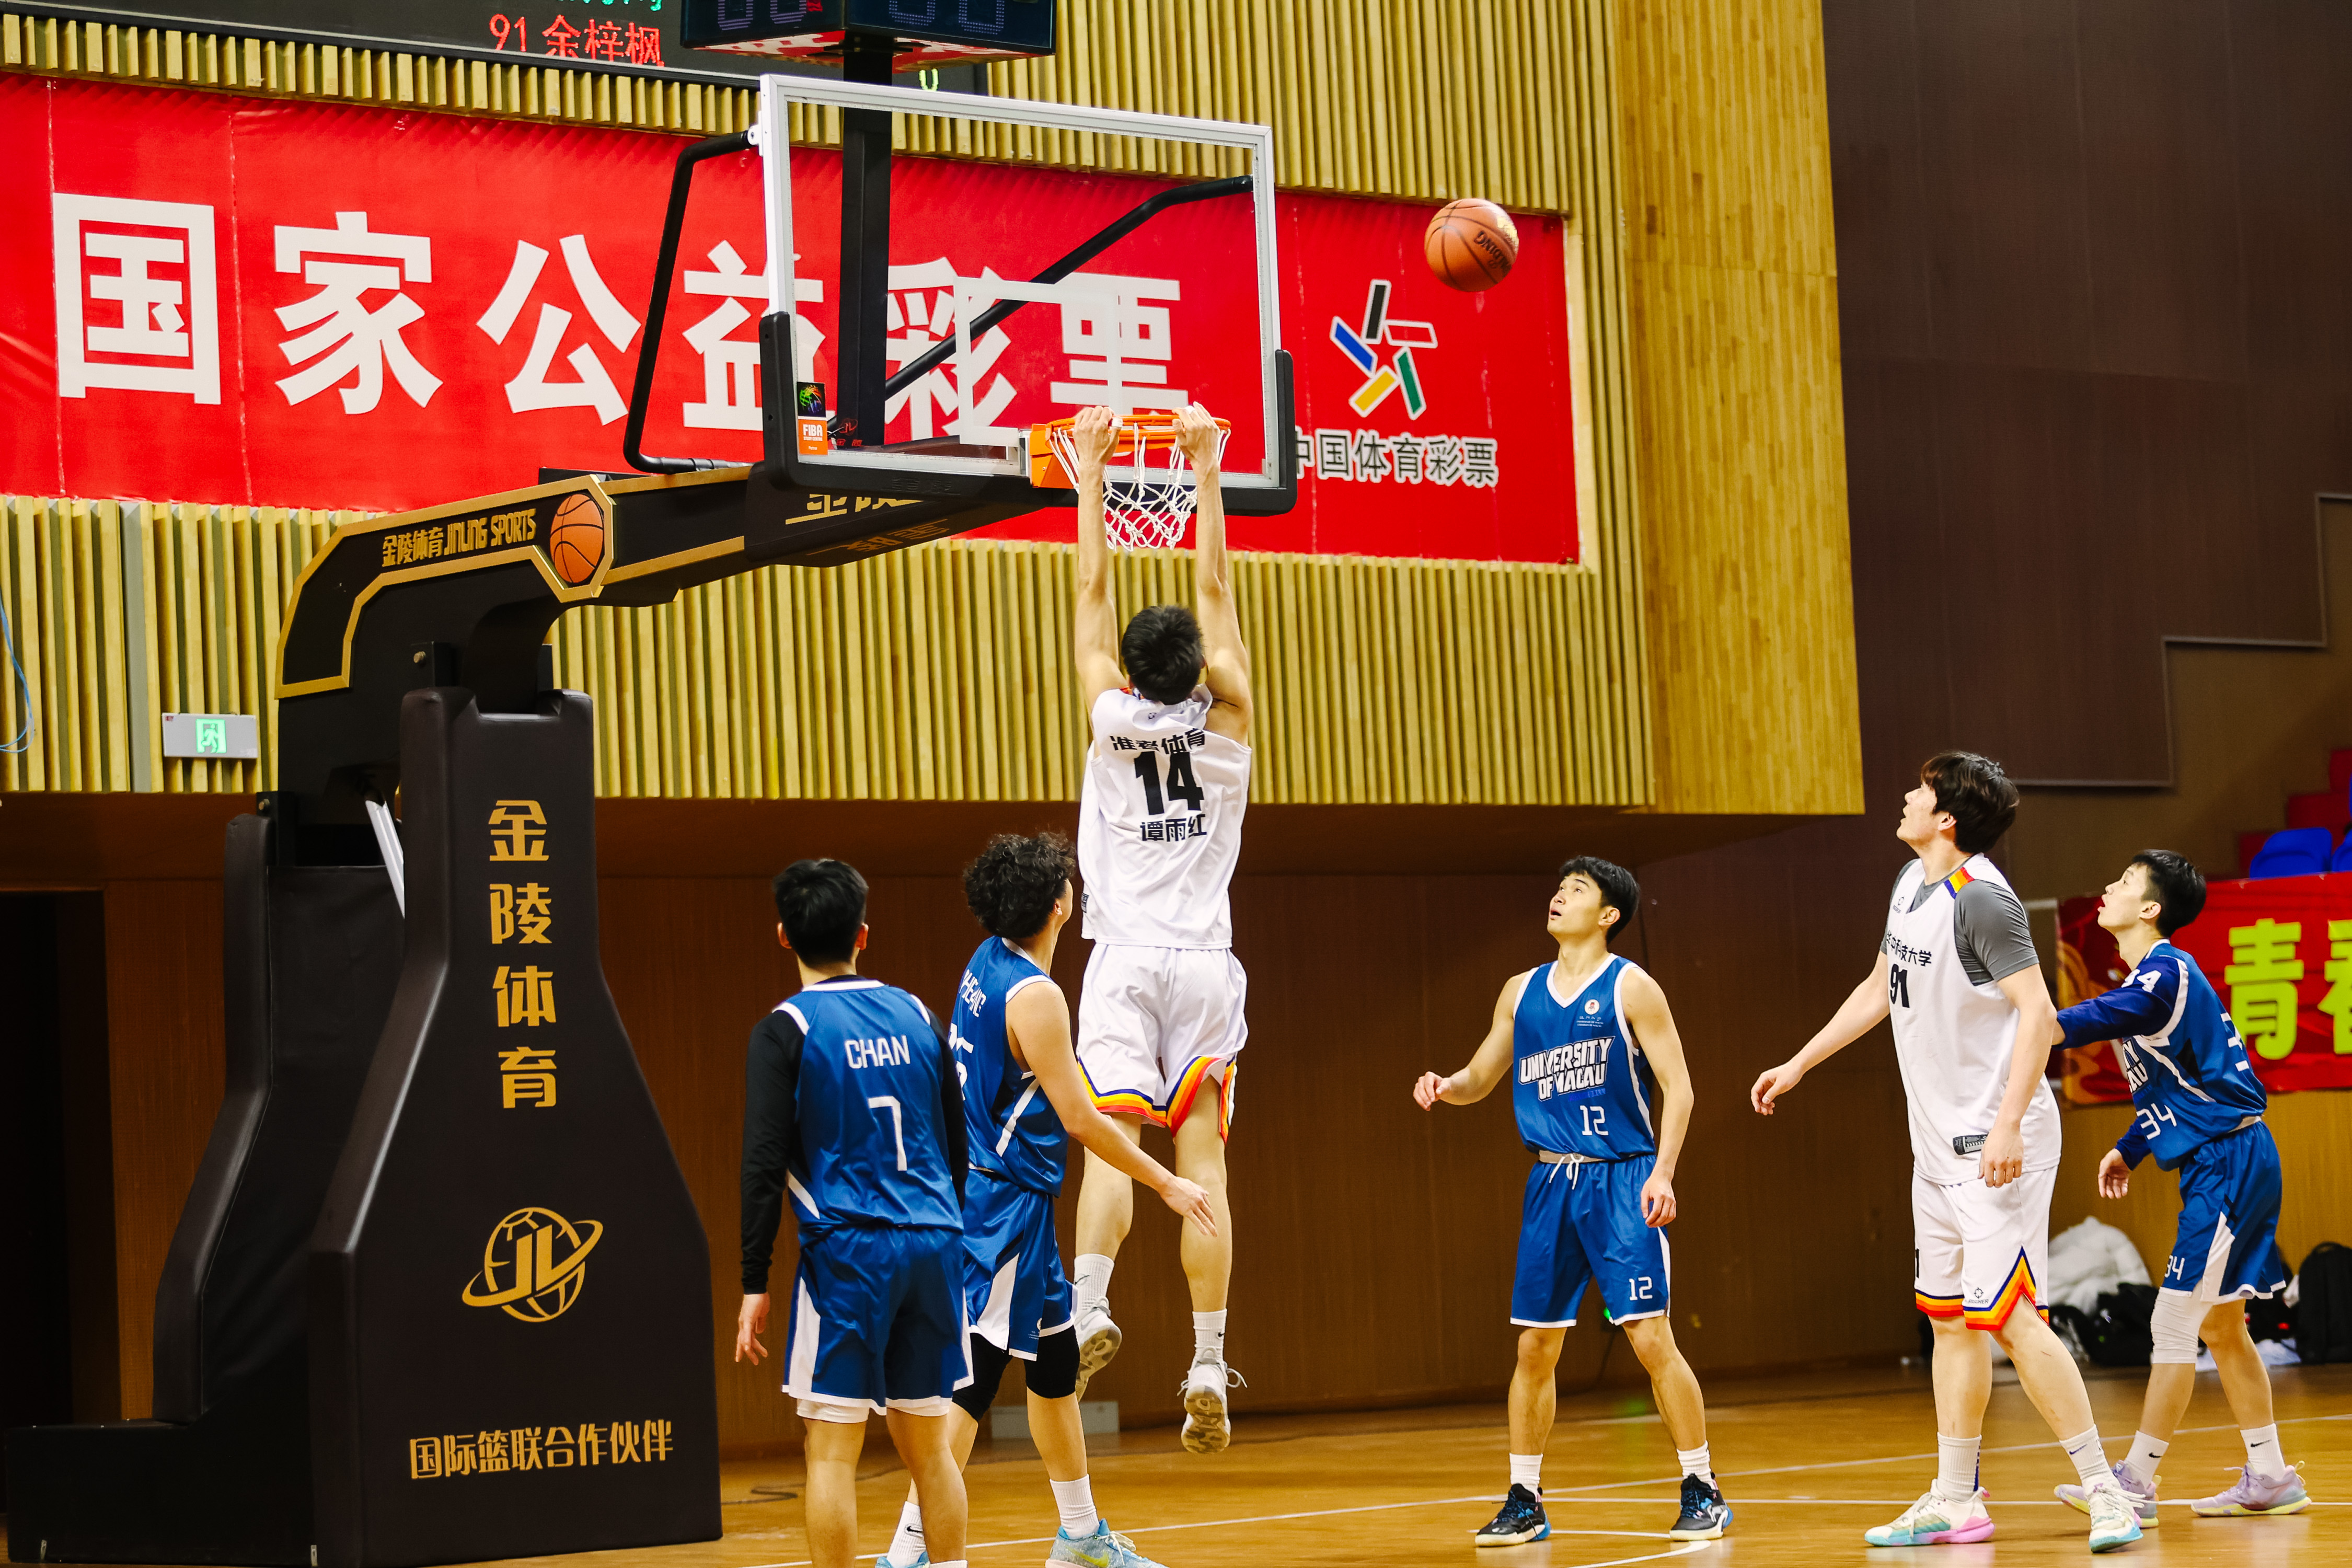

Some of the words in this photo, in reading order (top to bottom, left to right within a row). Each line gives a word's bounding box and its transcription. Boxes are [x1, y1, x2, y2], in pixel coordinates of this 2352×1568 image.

[489, 14, 526, 51] 91
[542, 14, 665, 67] 余梓枫
[53, 192, 1189, 457] 国家公益彩票
[803, 424, 823, 436] FIBA
[1295, 426, 1498, 488] 中国体育彩票
[382, 527, 443, 567] 金陵体育
[491, 509, 536, 546] SPORTS
[1133, 751, 1204, 815] 14
[1139, 814, 1207, 842] 谭雨红
[488, 800, 557, 1109] 金陵体育
[1890, 963, 1910, 1008] 91
[845, 1035, 910, 1069] CHAN
[1519, 1037, 1614, 1084] UNIVERSITY
[1538, 1075, 1554, 1101] OF
[1554, 1063, 1606, 1094] MACAU
[869, 1096, 907, 1171] 7
[1579, 1105, 1609, 1136] 12
[2136, 1103, 2177, 1140] 34
[1629, 1276, 1653, 1301] 12
[2164, 1254, 2185, 1281] 34
[410, 1420, 673, 1479] 国际篮联合作伙伴
